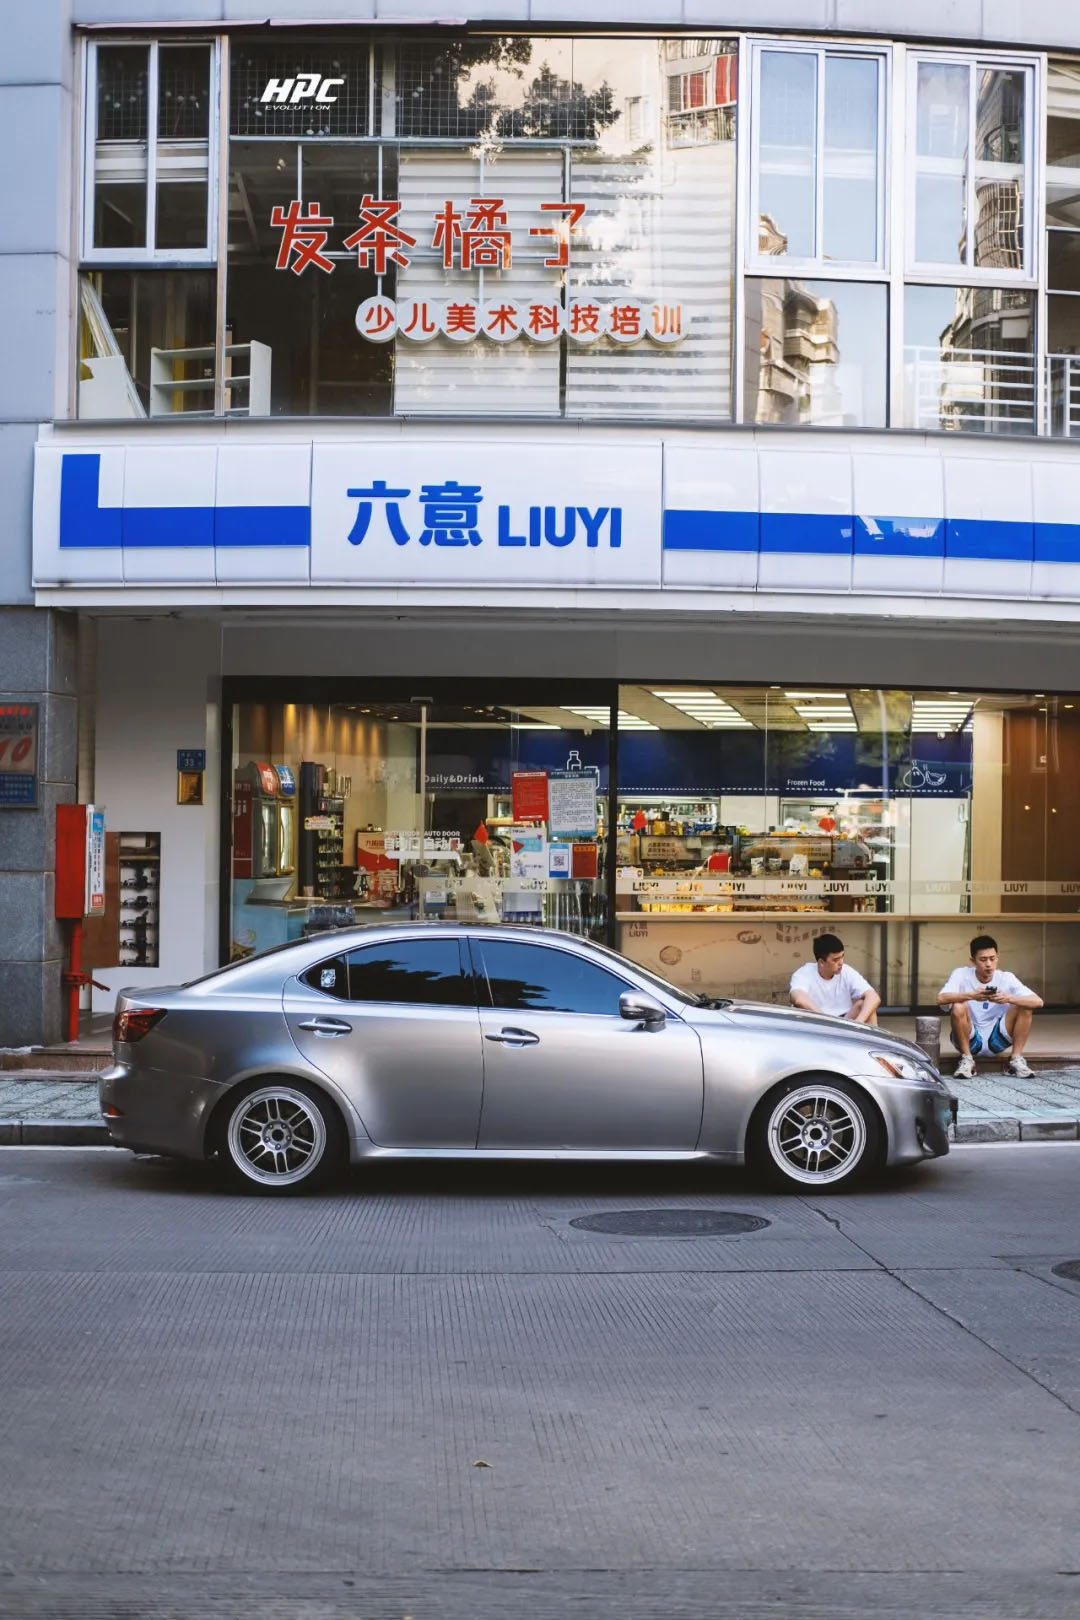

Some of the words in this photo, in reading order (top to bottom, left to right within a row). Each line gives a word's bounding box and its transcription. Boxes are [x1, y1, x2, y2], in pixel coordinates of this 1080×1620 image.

[270, 193, 587, 276] 发条橘子
[364, 302, 682, 336] 少儿美术科技培训
[346, 480, 483, 547] 六意
[498, 505, 622, 548] LIUYI
[424, 773, 485, 785] Daily&Drink
[787, 778, 808, 787] Frozen
[809, 778, 826, 787] Food
[823, 882, 850, 893] LIUYI
[1003, 882, 1029, 893] LIUYI
